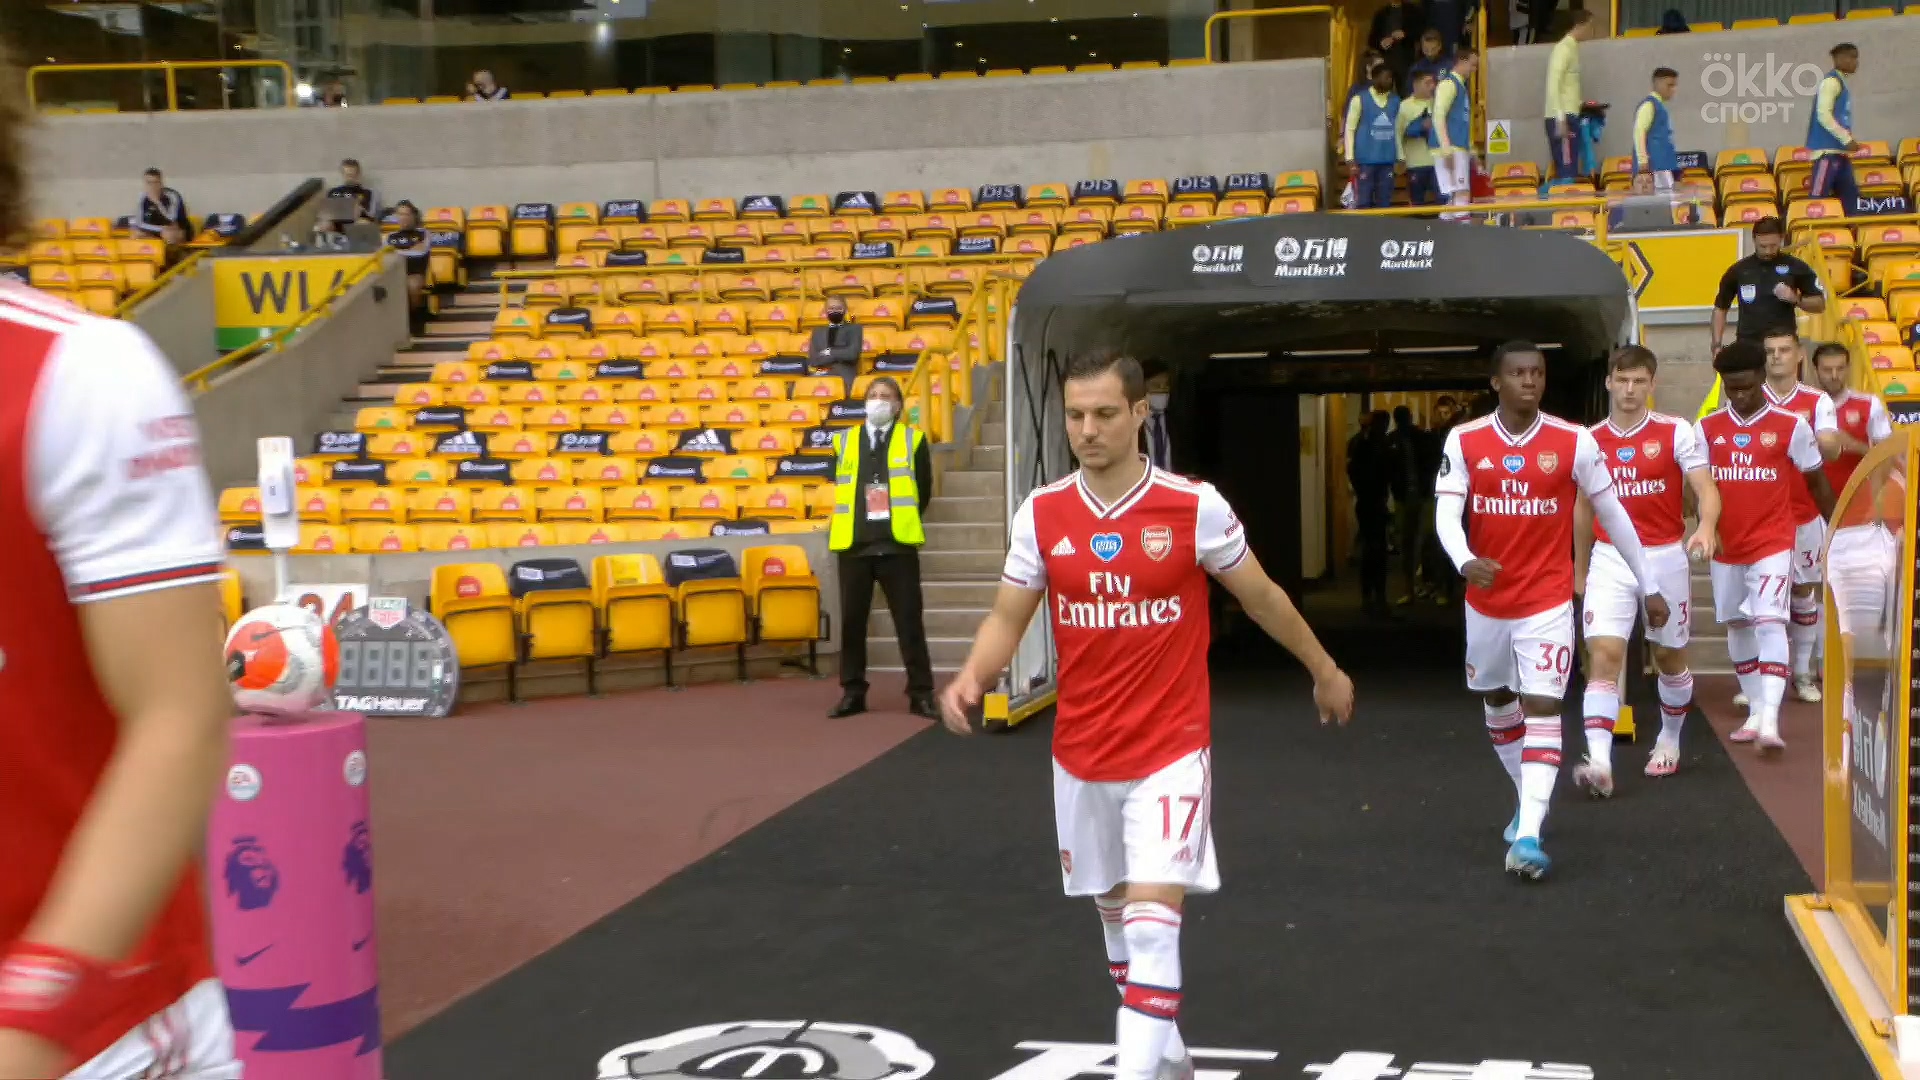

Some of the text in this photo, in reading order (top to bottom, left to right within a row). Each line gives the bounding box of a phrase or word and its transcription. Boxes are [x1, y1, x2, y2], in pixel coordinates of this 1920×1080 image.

[1731, 451, 1753, 466] Fly
[1711, 464, 1778, 481] Emirates
[1501, 478, 1529, 496] Fly
[1473, 494, 1558, 516] Emirates
[1089, 571, 1130, 596] Fly
[1758, 574, 1788, 599] 77
[1057, 593, 1183, 629] Emirates
[1535, 642, 1571, 676] 30
[1158, 795, 1202, 842] 17
